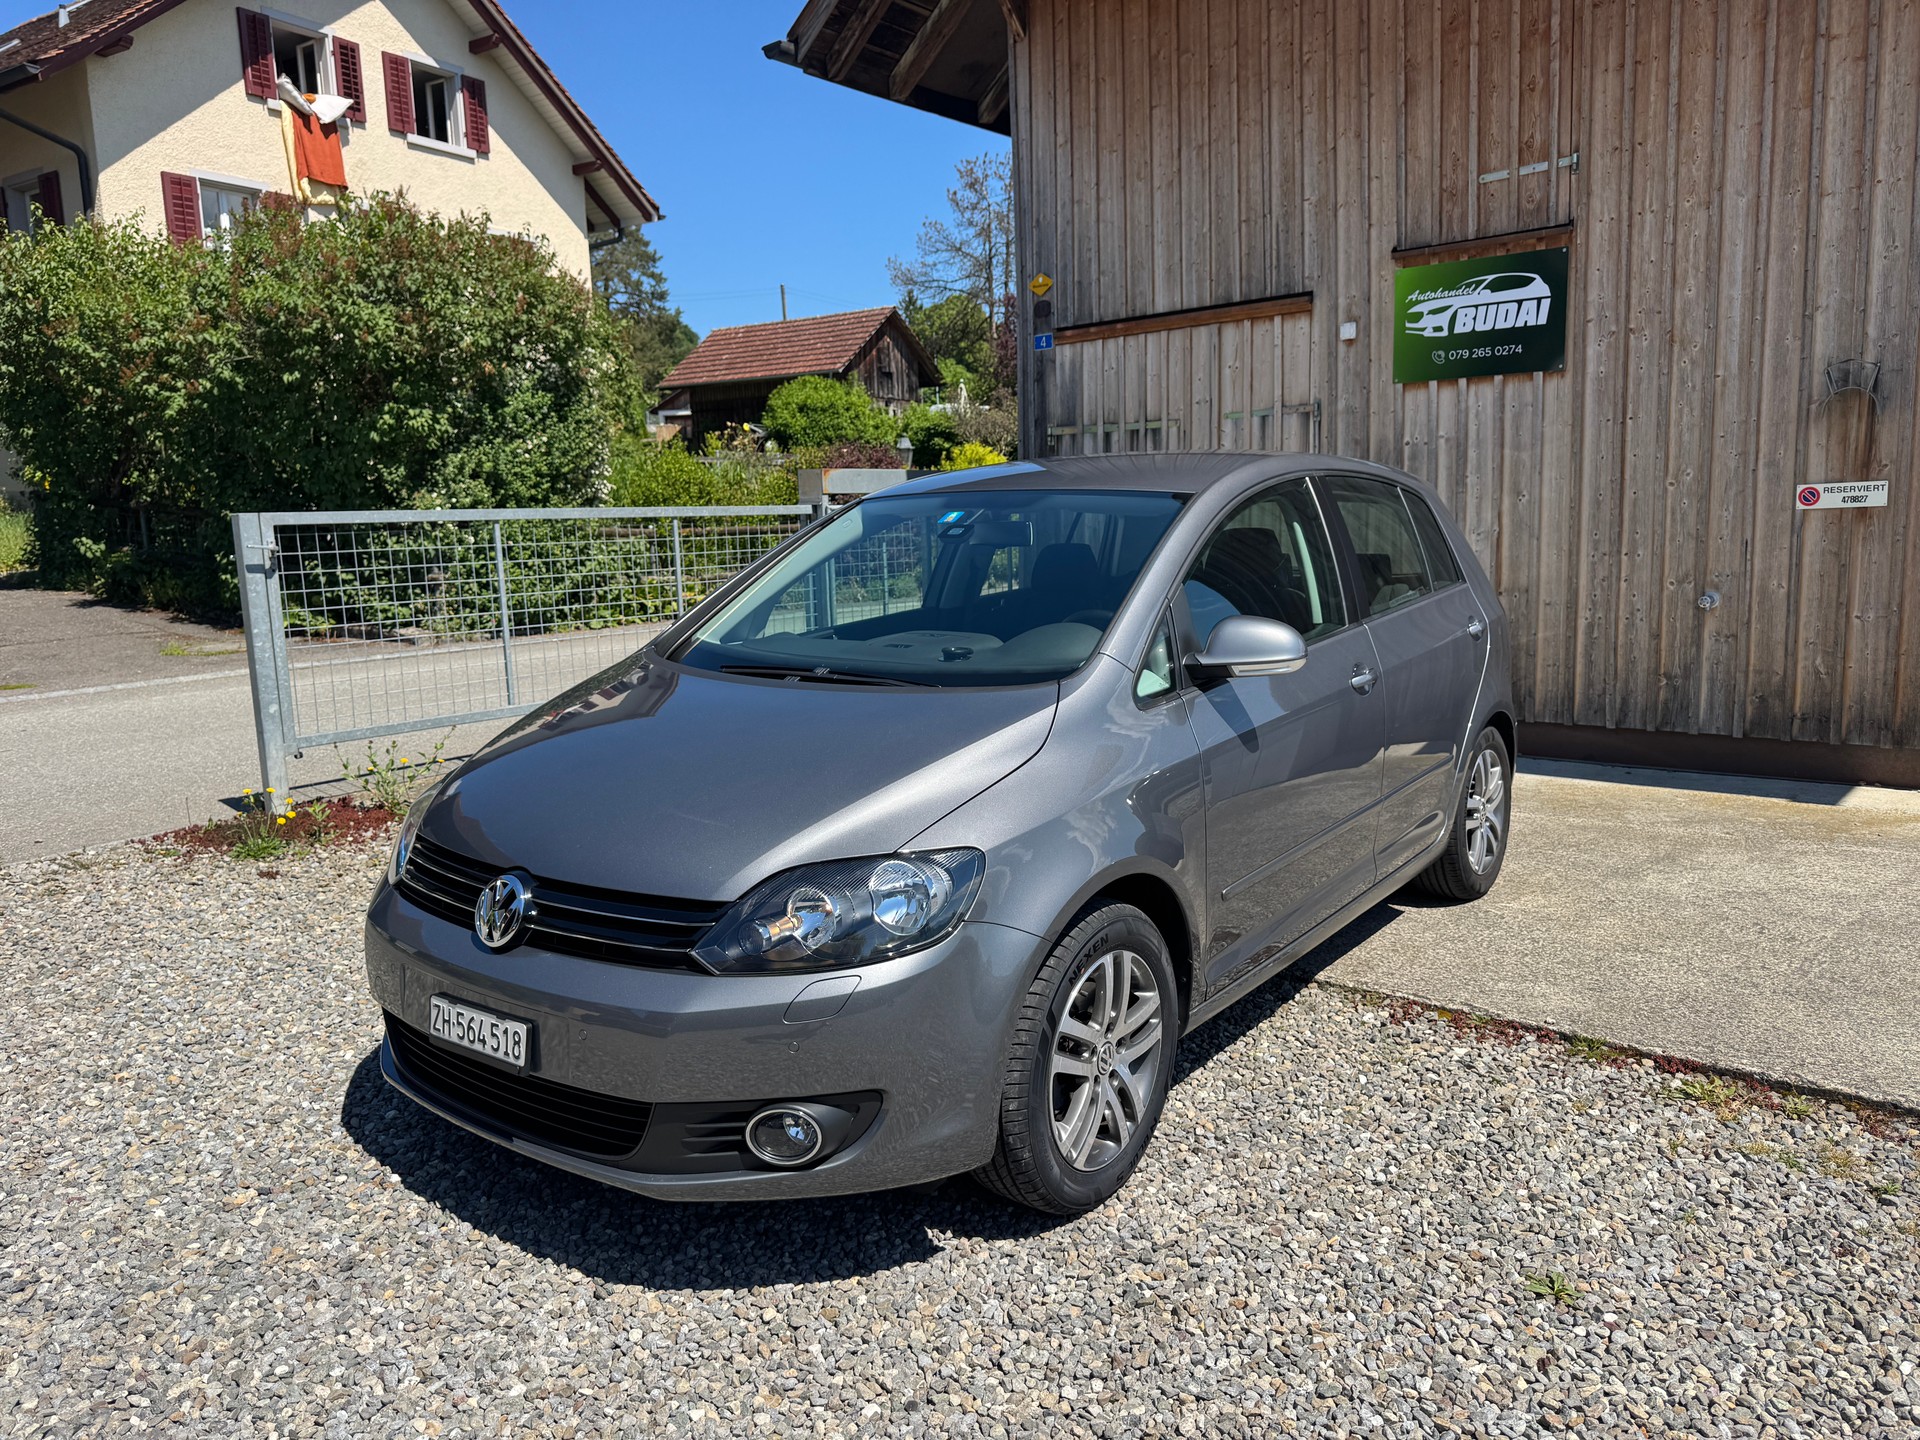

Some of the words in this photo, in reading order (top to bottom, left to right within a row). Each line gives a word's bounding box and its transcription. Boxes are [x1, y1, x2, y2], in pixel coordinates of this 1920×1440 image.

[1405, 283, 1476, 303] Autohandel
[1453, 298, 1551, 334] BUDAI
[1040, 336, 1047, 348] 4
[1448, 349, 1470, 360] 079
[1472, 347, 1492, 358] 265
[1494, 344, 1523, 356] 0274
[1823, 484, 1886, 494] RESERVIERT
[475, 874, 525, 948] VW
[1068, 933, 1109, 987] NEXEN
